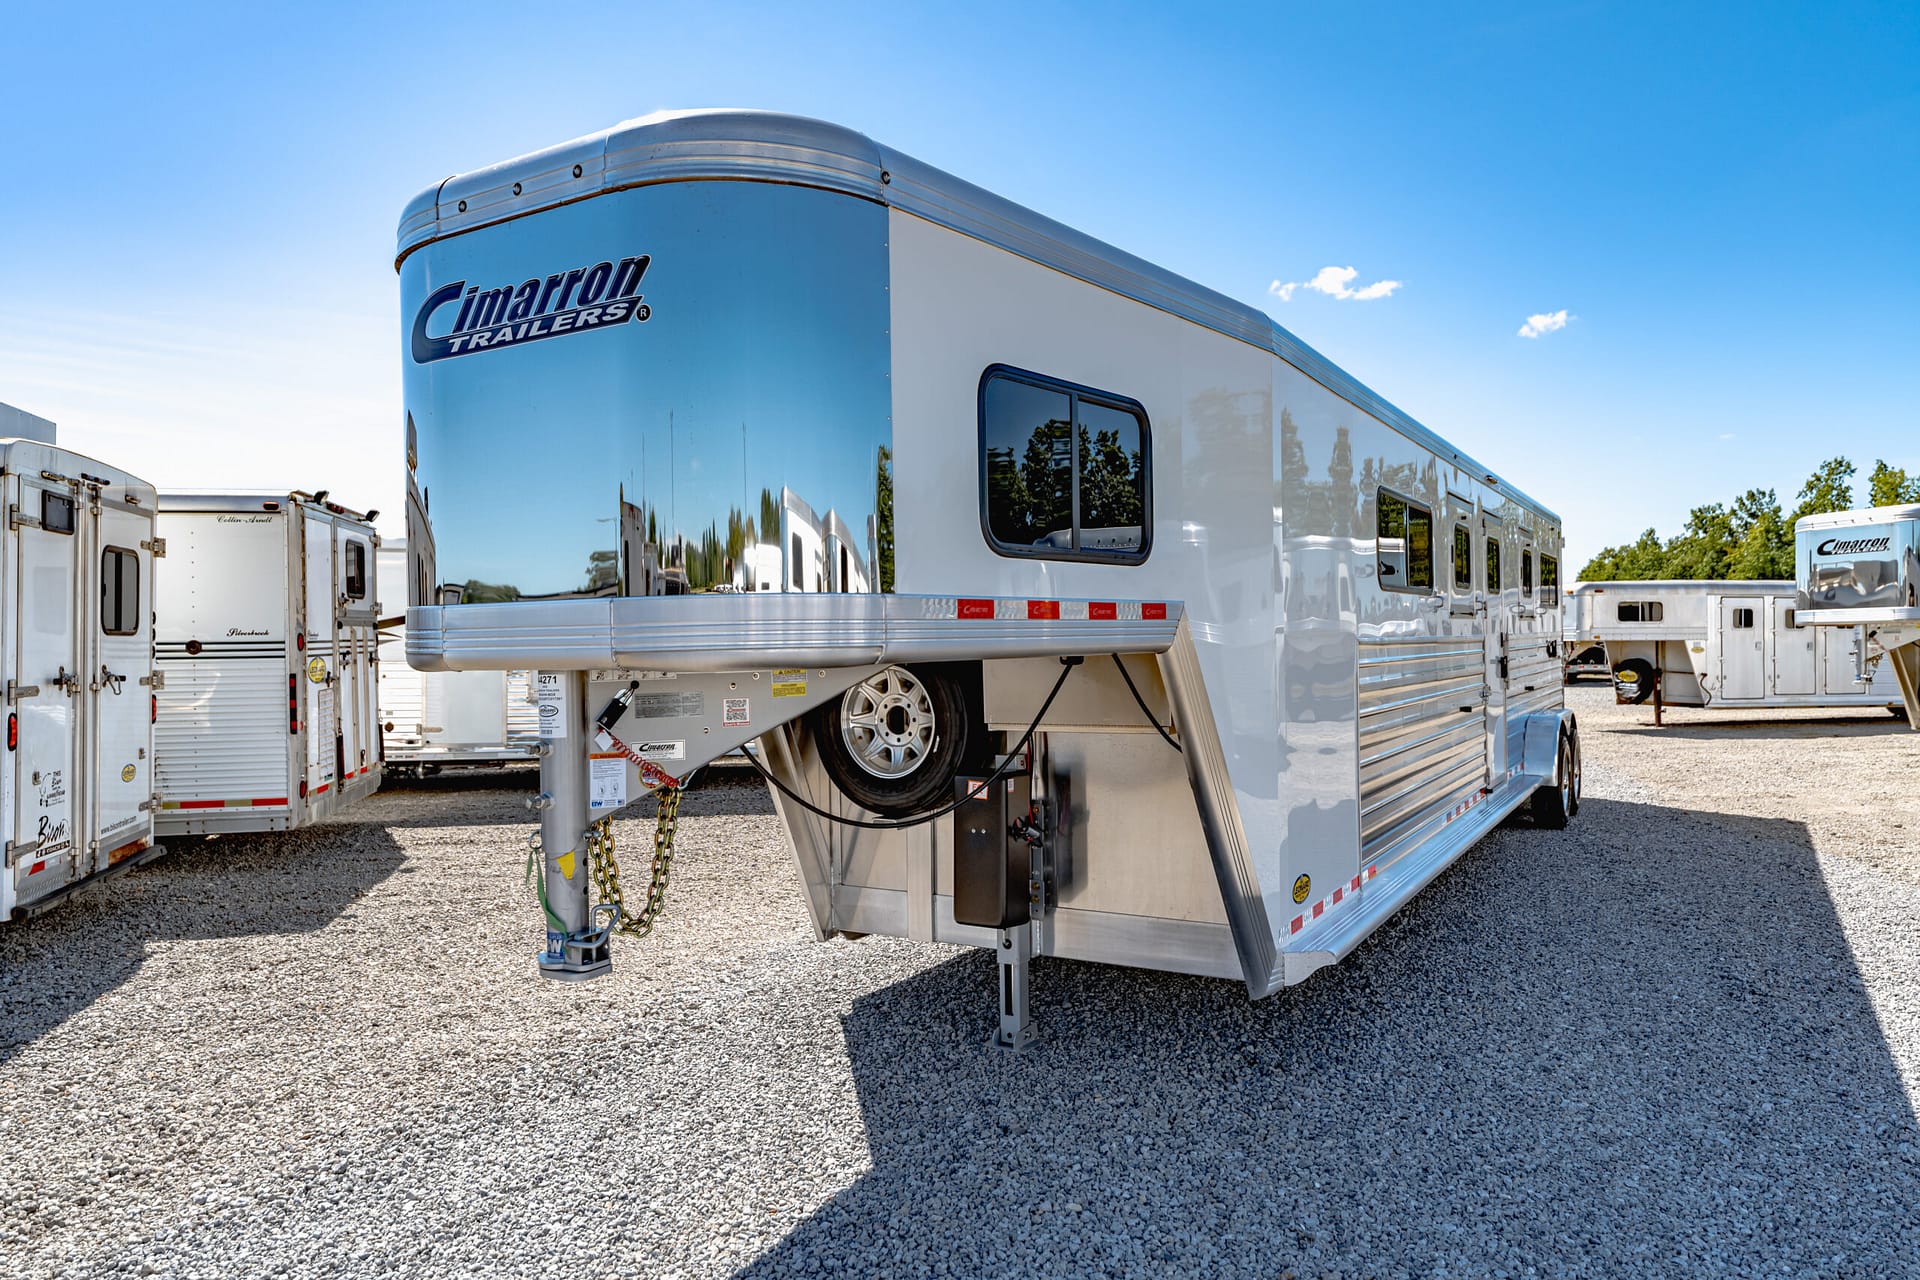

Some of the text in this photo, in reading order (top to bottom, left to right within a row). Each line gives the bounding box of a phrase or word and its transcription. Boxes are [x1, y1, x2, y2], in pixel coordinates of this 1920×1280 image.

[411, 254, 652, 365] Cimarron
[448, 302, 630, 354] TRAILERS
[1816, 537, 1890, 556] Cimarron
